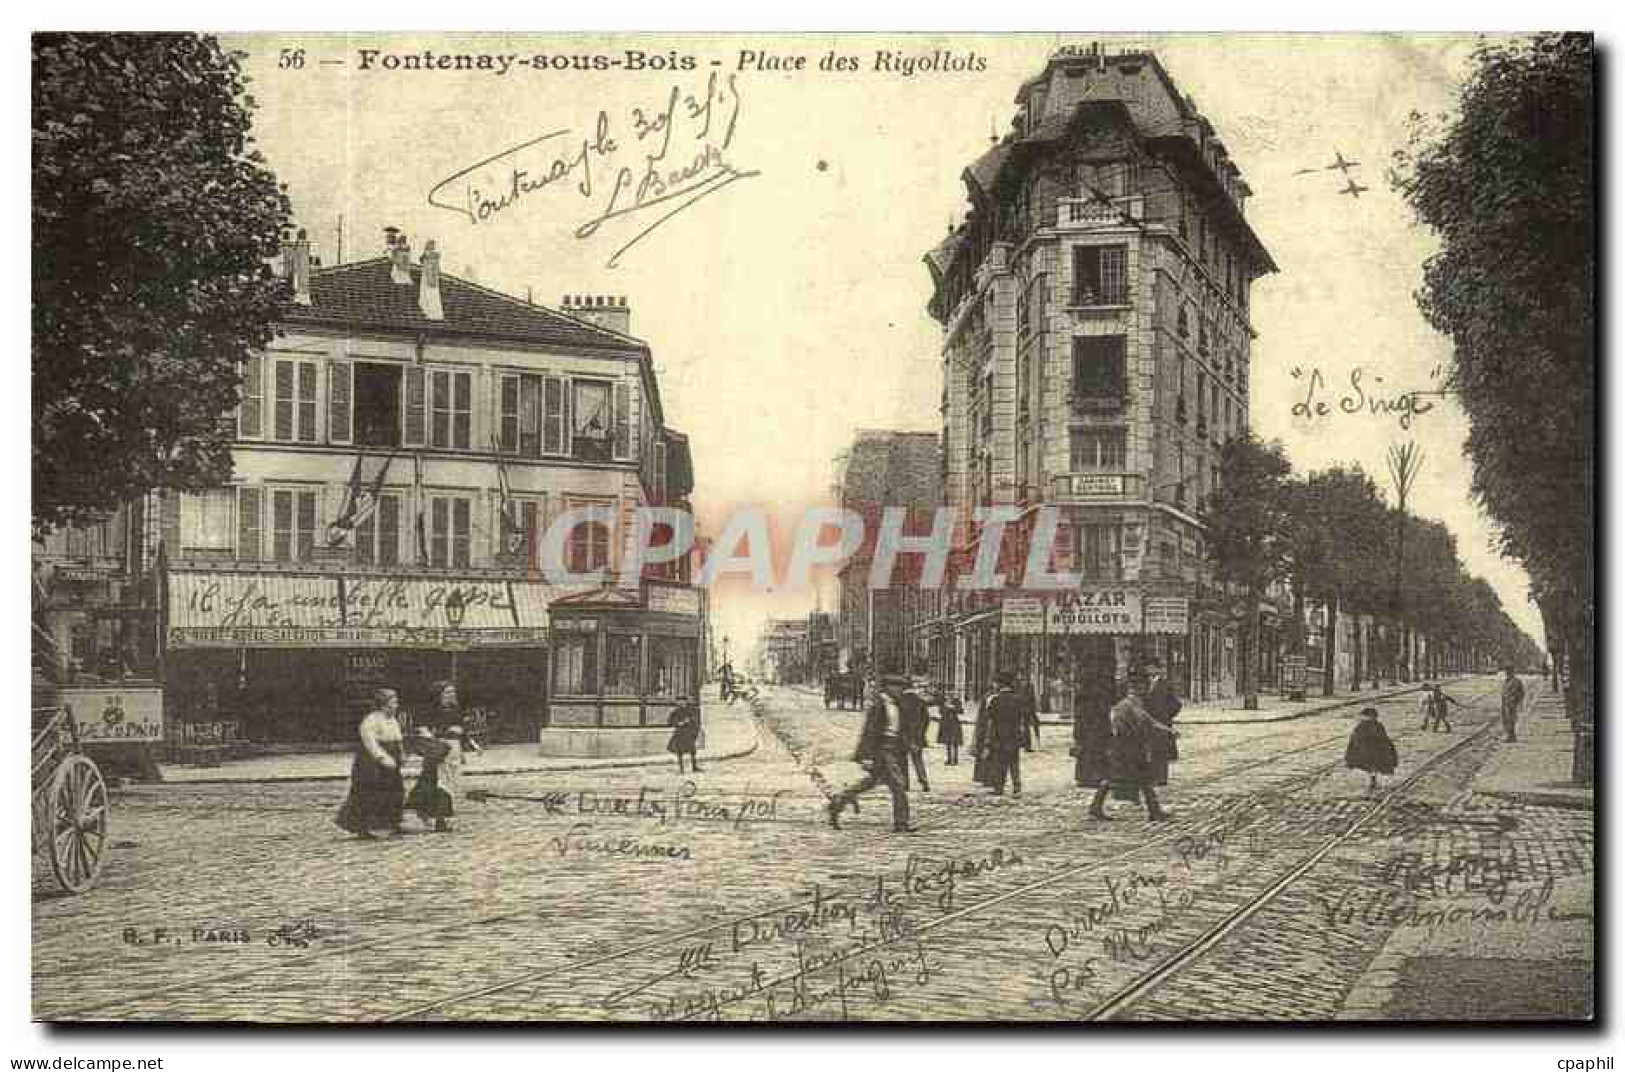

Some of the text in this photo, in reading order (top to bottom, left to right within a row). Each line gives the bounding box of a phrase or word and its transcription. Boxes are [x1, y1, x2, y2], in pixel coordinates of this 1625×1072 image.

[279, 48, 988, 76] 56 Fontenay-sous-Bois Place des Rigollots
